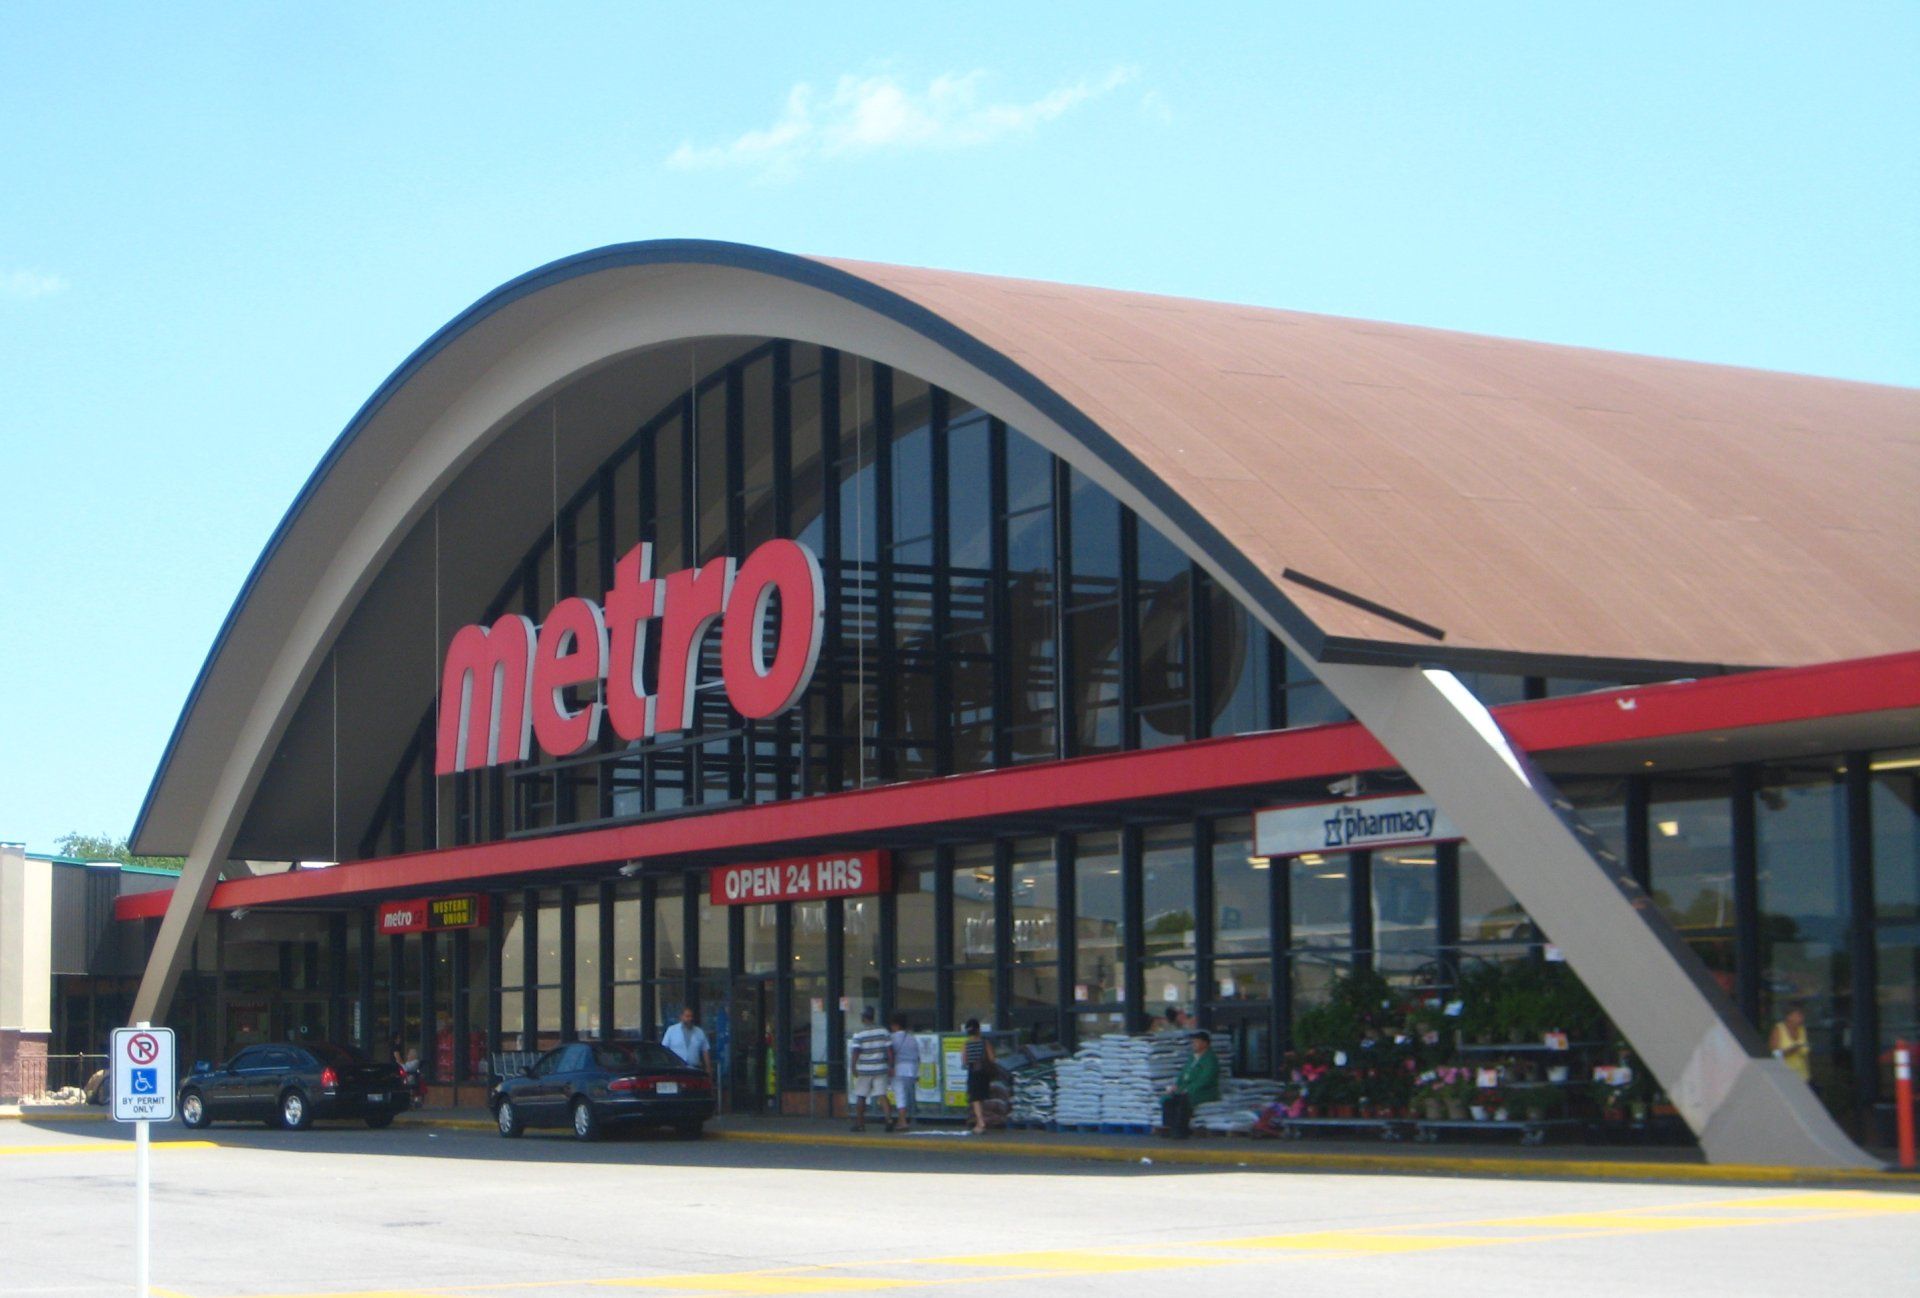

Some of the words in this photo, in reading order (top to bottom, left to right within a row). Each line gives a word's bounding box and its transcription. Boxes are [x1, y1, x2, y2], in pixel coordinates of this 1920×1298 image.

[436, 538, 825, 776] metro
[1345, 808, 1436, 844] pharmacy
[725, 866, 780, 899] OPEN
[786, 864, 810, 894] 24
[817, 858, 862, 891] HRS
[433, 899, 469, 913] WESTERN
[384, 910, 412, 927] metro
[443, 912, 469, 925] UNION
[122, 1097, 133, 1105] BY
[137, 1096, 165, 1105] PERMIT
[133, 1105, 155, 1113] ONLY
